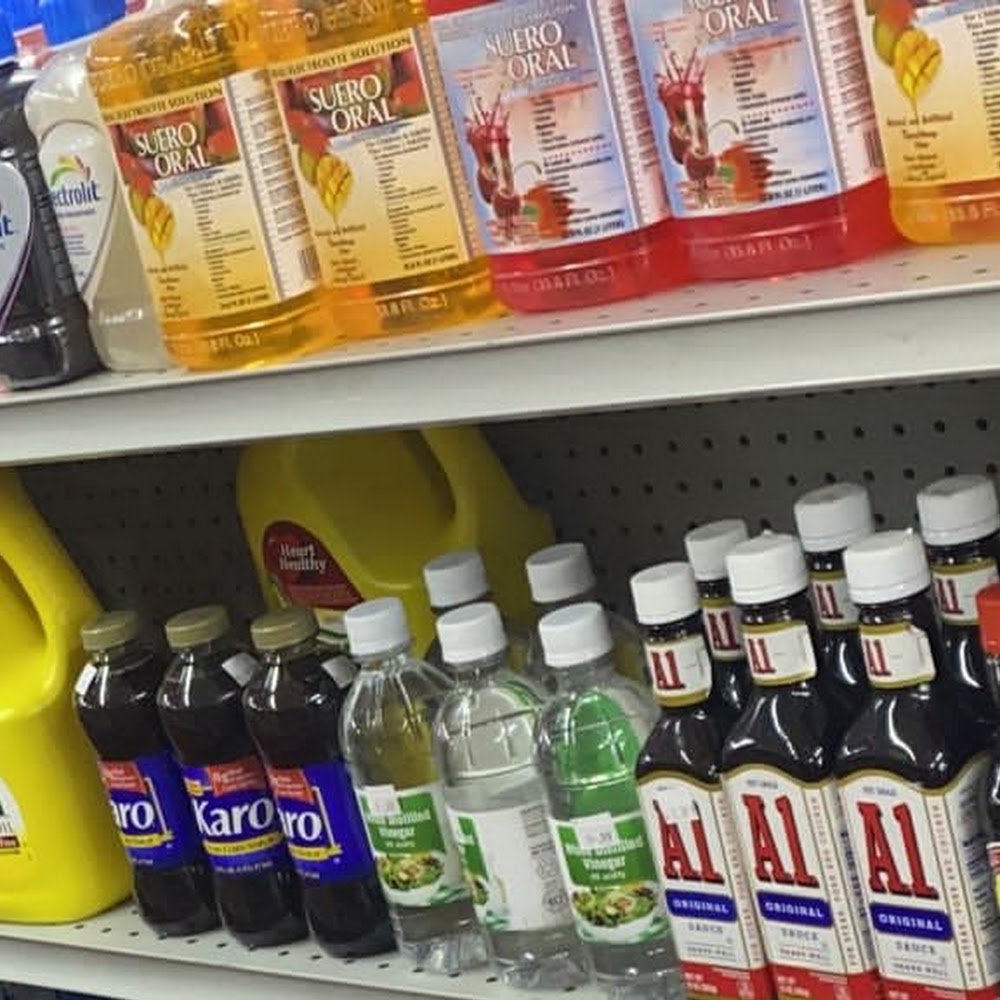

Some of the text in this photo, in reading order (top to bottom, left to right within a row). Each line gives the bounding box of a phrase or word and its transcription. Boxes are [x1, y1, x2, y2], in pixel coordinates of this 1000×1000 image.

[705, 0, 779, 36] ORAL
[350, 36, 411, 60] SOLUTION
[485, 20, 563, 57] SUERO
[508, 47, 576, 82] ORAL
[308, 74, 382, 113] SUERO
[331, 97, 398, 133] ORAL
[135, 122, 197, 157] SUERO
[154, 144, 211, 177] ORAL
[279, 543, 316, 557] Heart
[279, 555, 328, 574] Healthy
[191, 797, 275, 837] Karo
[277, 807, 323, 842] ro
[741, 793, 820, 889] A1
[857, 800, 940, 901] A1
[583, 856, 626, 871] Vinegar
[765, 901, 825, 919] ORIGINAL
[877, 912, 944, 932] ORIGINAL
